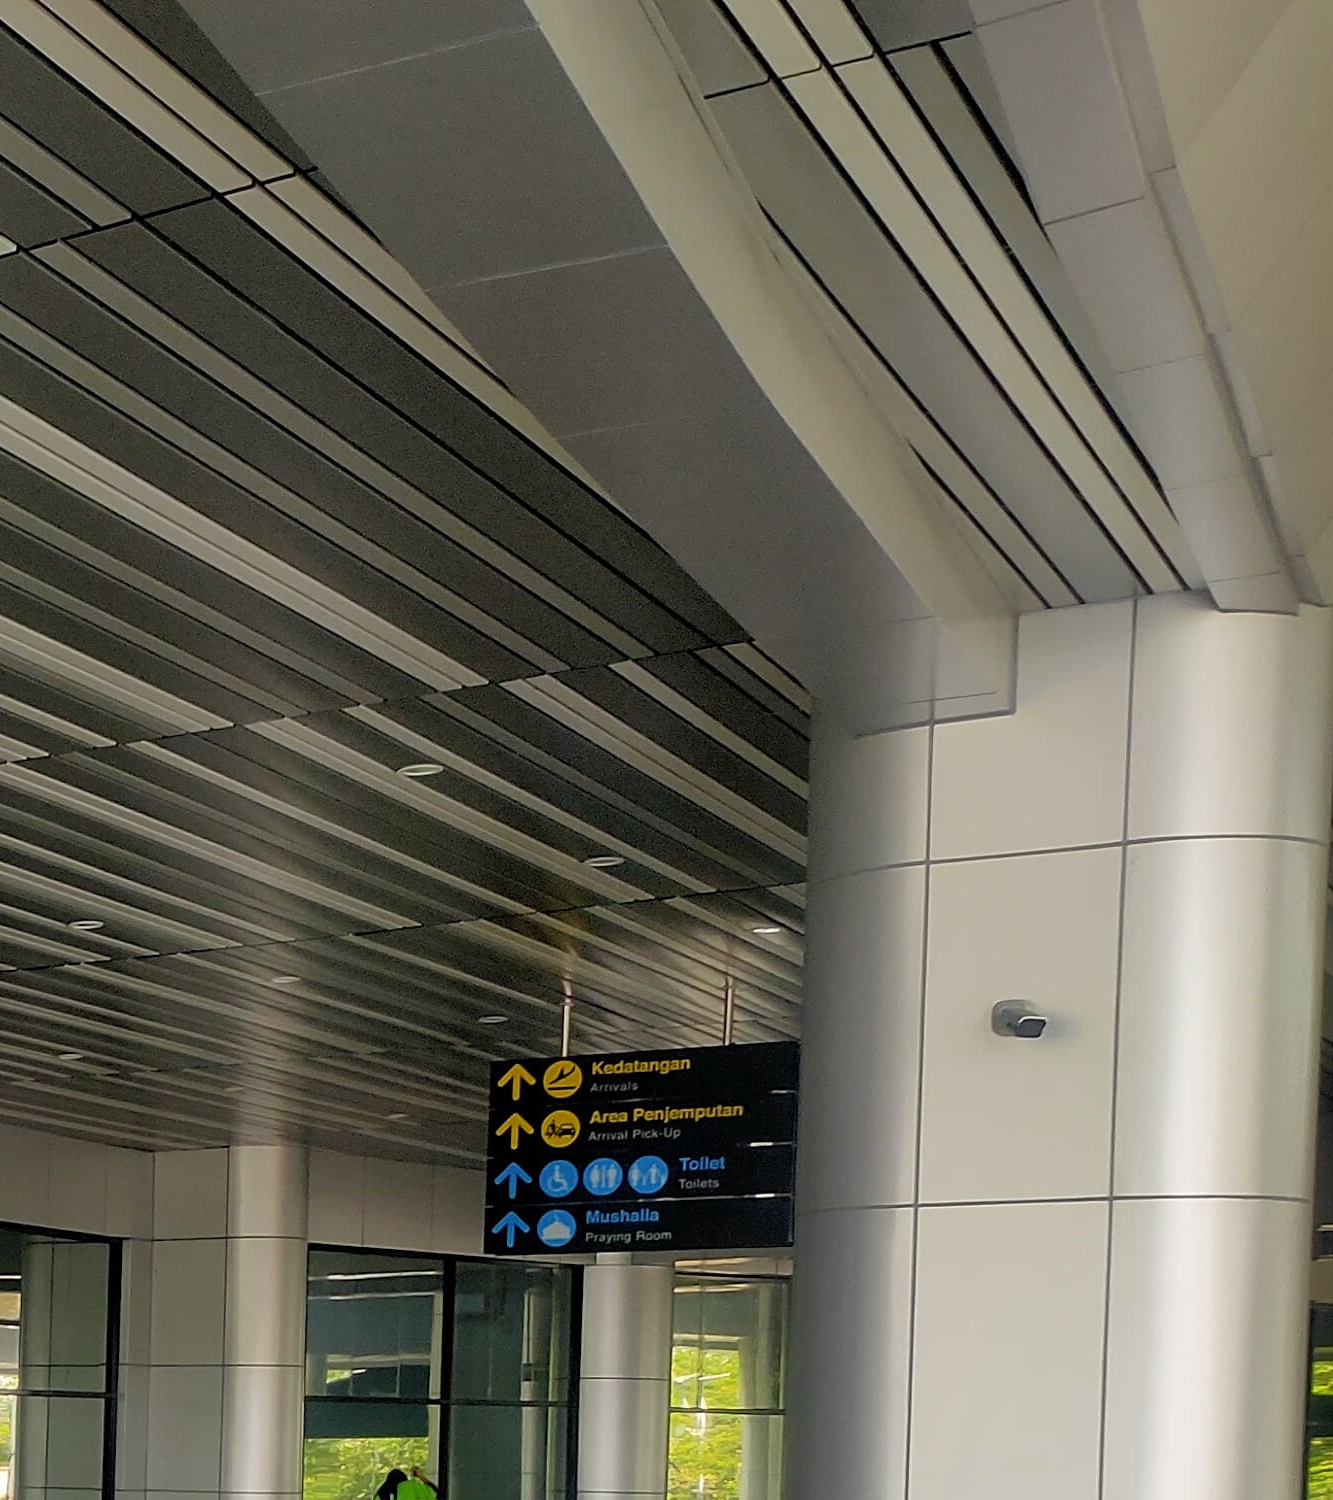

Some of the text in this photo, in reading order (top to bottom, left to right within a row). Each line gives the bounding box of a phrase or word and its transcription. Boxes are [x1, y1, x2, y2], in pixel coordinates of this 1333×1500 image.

[591, 1058, 691, 1075] Kedatangan
[590, 1081, 639, 1093] Arrivals
[589, 1104, 744, 1124] Area Penjemputan
[588, 1127, 681, 1142] Arrival Pick-Up
[679, 1156, 726, 1171] Toilet
[679, 1178, 720, 1190] Toilets
[586, 1208, 659, 1224] Mushalla
[585, 1230, 672, 1244] Praying Room
